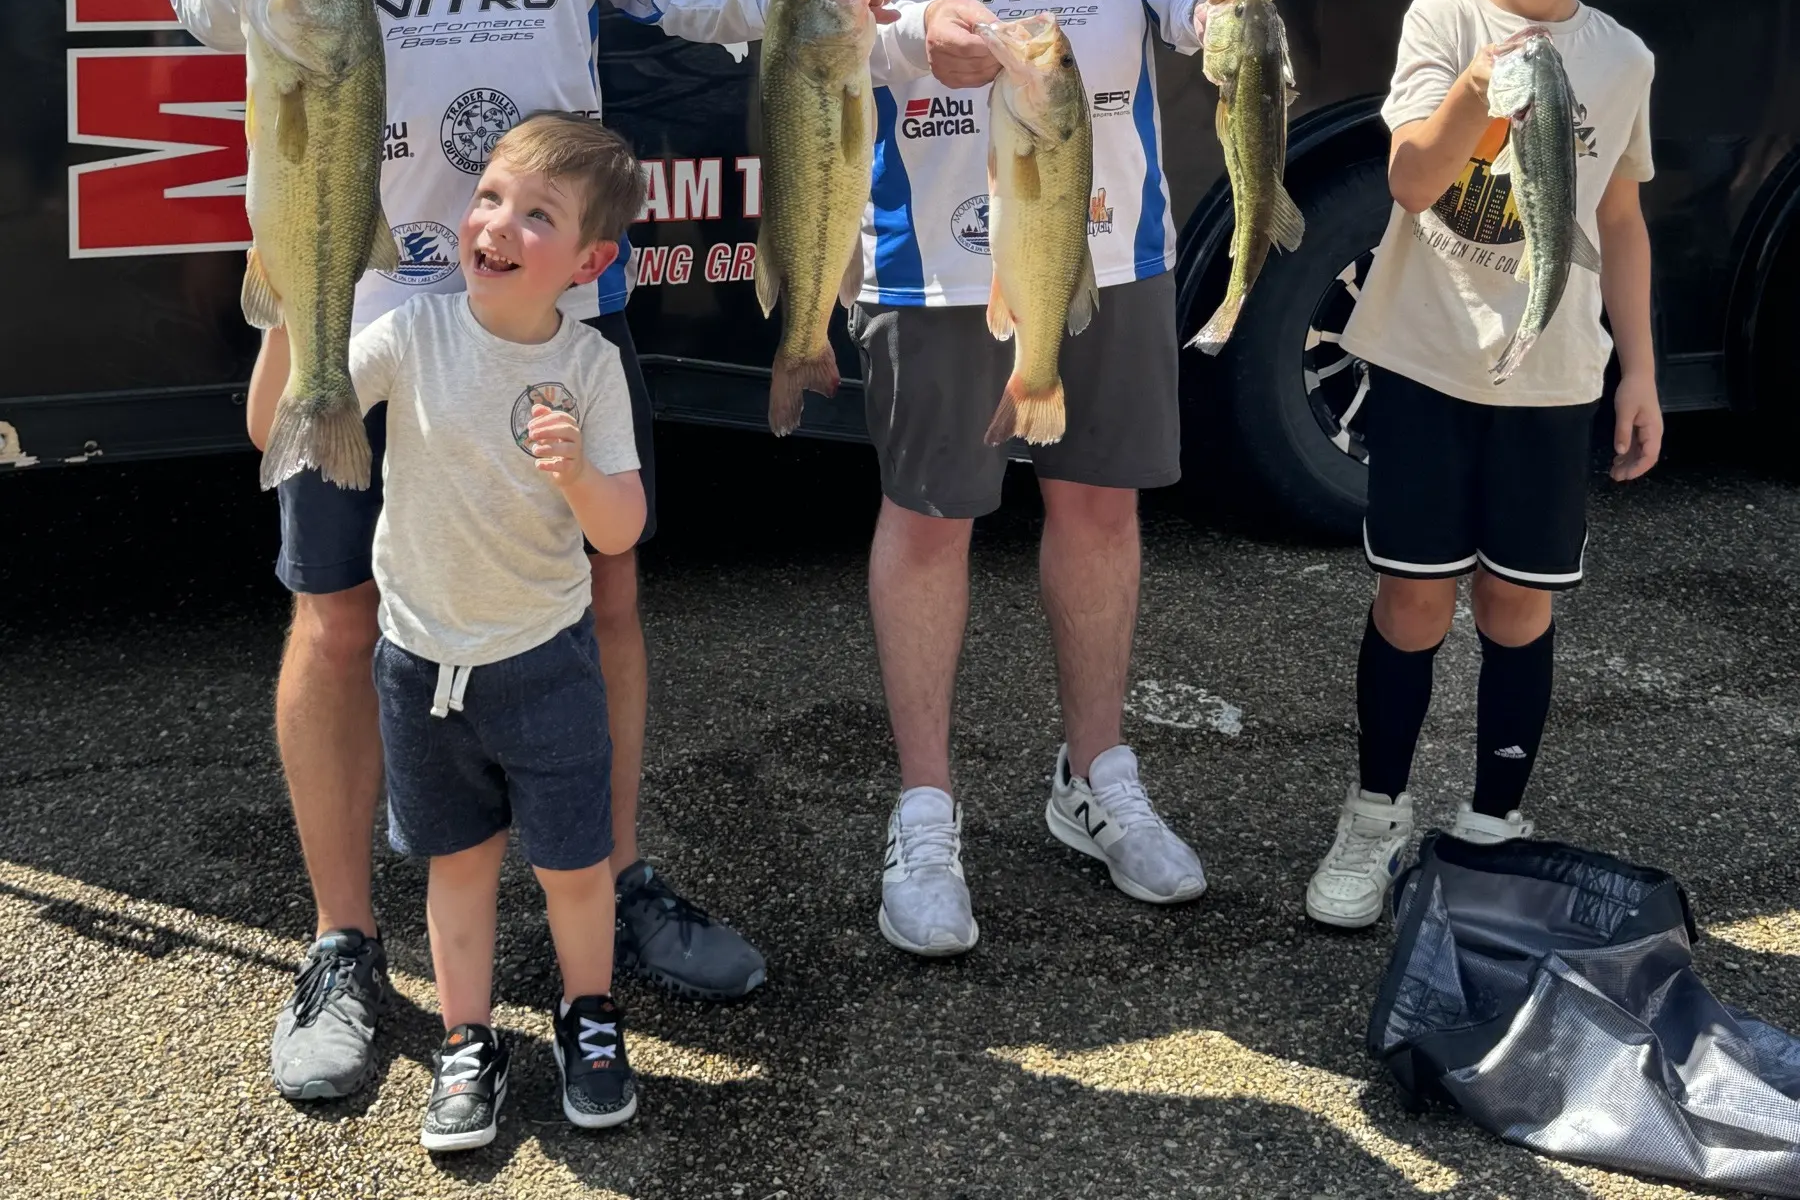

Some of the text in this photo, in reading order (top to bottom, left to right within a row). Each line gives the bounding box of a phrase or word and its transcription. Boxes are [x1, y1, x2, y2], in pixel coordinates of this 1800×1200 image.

[400, 31, 535, 49] Bass Boats
[446, 91, 484, 122] TRADER
[929, 96, 974, 118] Abu
[902, 118, 975, 139] Garcia
[632, 157, 722, 223] AM
[393, 223, 459, 250] NTAIN HARBOR
[704, 242, 757, 283] GR
[1427, 229, 1452, 251] YOU
[1451, 240, 1468, 259] ON
[1469, 247, 1496, 268] THE
[1495, 256, 1519, 275] COU
